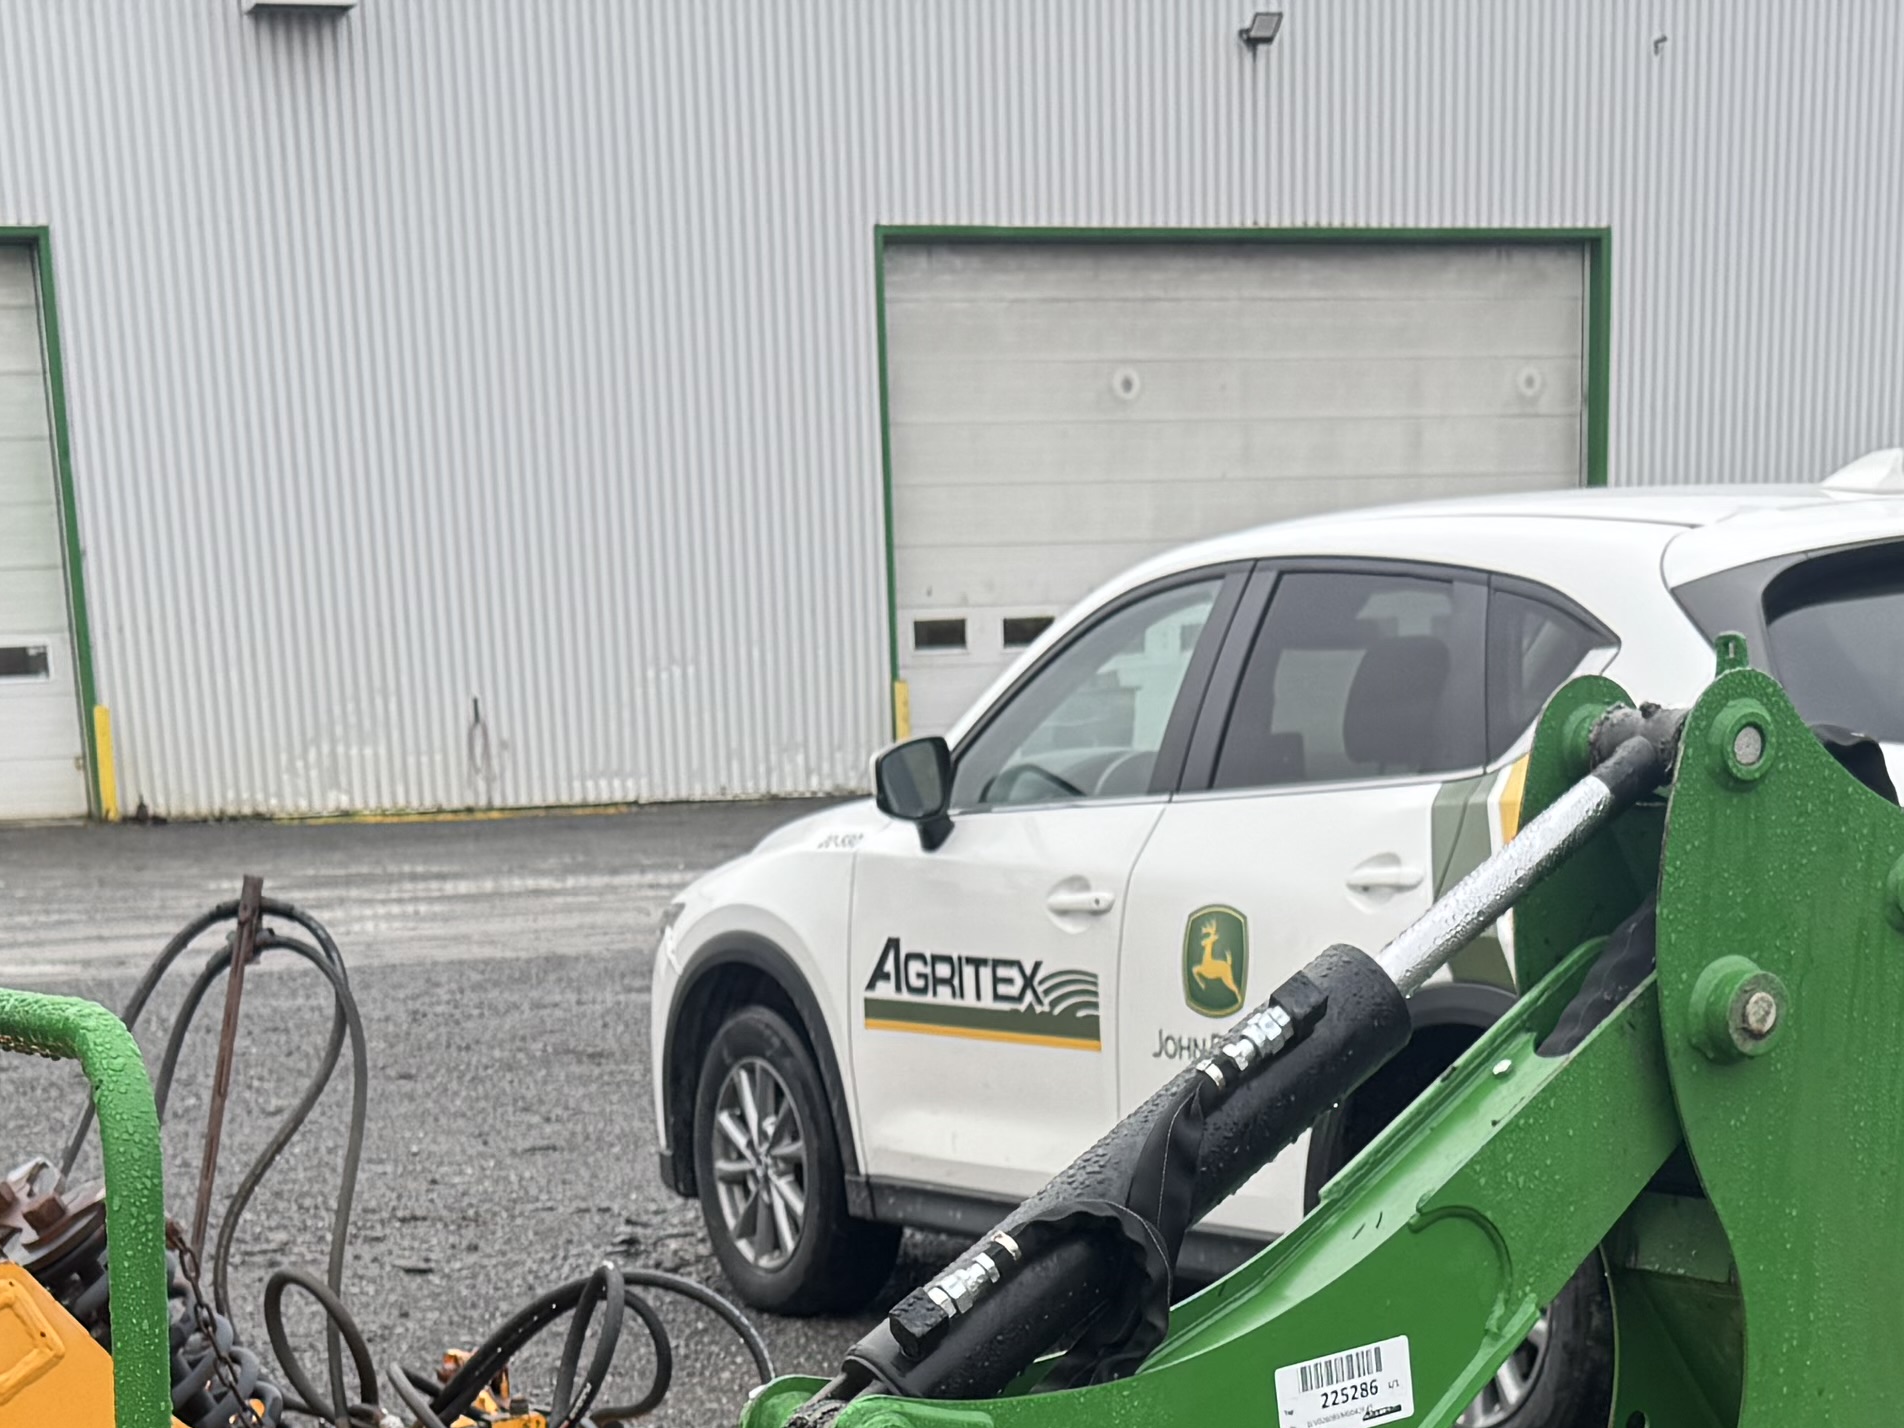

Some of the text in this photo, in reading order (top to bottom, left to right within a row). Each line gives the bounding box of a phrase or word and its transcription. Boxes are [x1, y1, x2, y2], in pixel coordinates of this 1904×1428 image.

[864, 937, 1044, 1006] AGRITEX
[1152, 1029, 1207, 1060] JOHN
[1321, 1379, 1379, 1409] 225286
